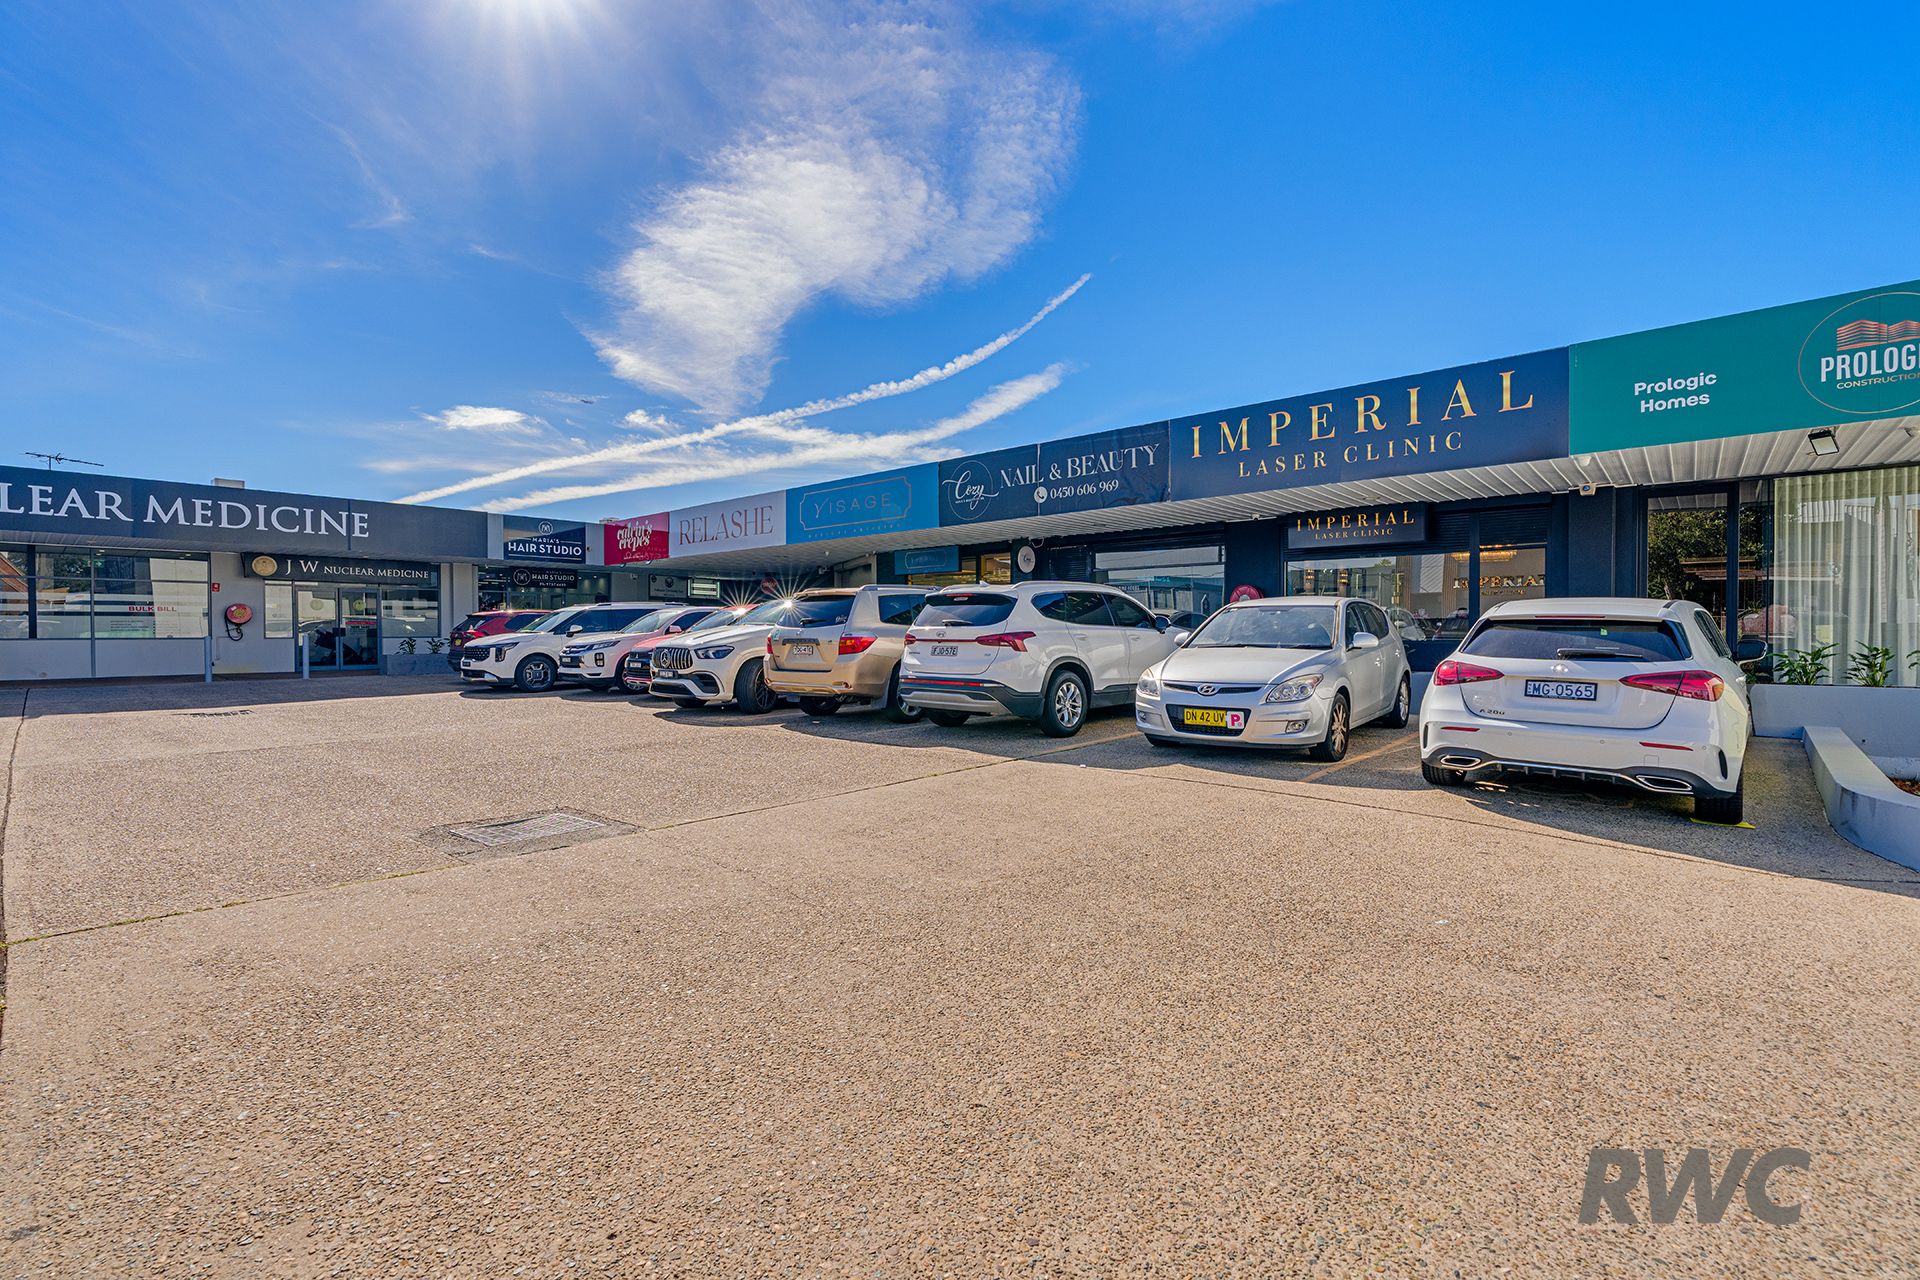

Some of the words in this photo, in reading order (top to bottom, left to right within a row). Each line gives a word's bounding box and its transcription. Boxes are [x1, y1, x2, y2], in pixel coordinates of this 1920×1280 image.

[1821, 343, 1920, 382] PROLOG
[1634, 372, 1717, 396] Prologic
[1191, 370, 1534, 459] IMPERIAL
[1640, 393, 1710, 413] Homes
[1000, 464, 1044, 488] NAIL
[1050, 462, 1062, 481] &
[1067, 443, 1161, 478] BEAUTY
[1239, 450, 1327, 478] LASER
[1343, 431, 1463, 463] CLINIC
[942, 470, 999, 510] Cozy
[1050, 485, 1075, 499] 0450
[1076, 482, 1097, 496] 606
[1099, 479, 1119, 493] 969
[143, 494, 369, 538] MEDICINE
[679, 505, 774, 545] RELASHE
[1297, 510, 1415, 532] IMPERIAL
[1315, 531, 1349, 540] LASER
[1352, 528, 1394, 538] CLINIC
[508, 542, 537, 553] HAIR
[539, 544, 582, 556] STUDIO
[285, 560, 292, 576] J
[300, 560, 319, 573] W
[324, 566, 375, 577] NUCLEAR
[377, 569, 429, 579] MEDICINE
[549, 574, 575, 582] STUDIO
[1231, 713, 1241, 726] P
